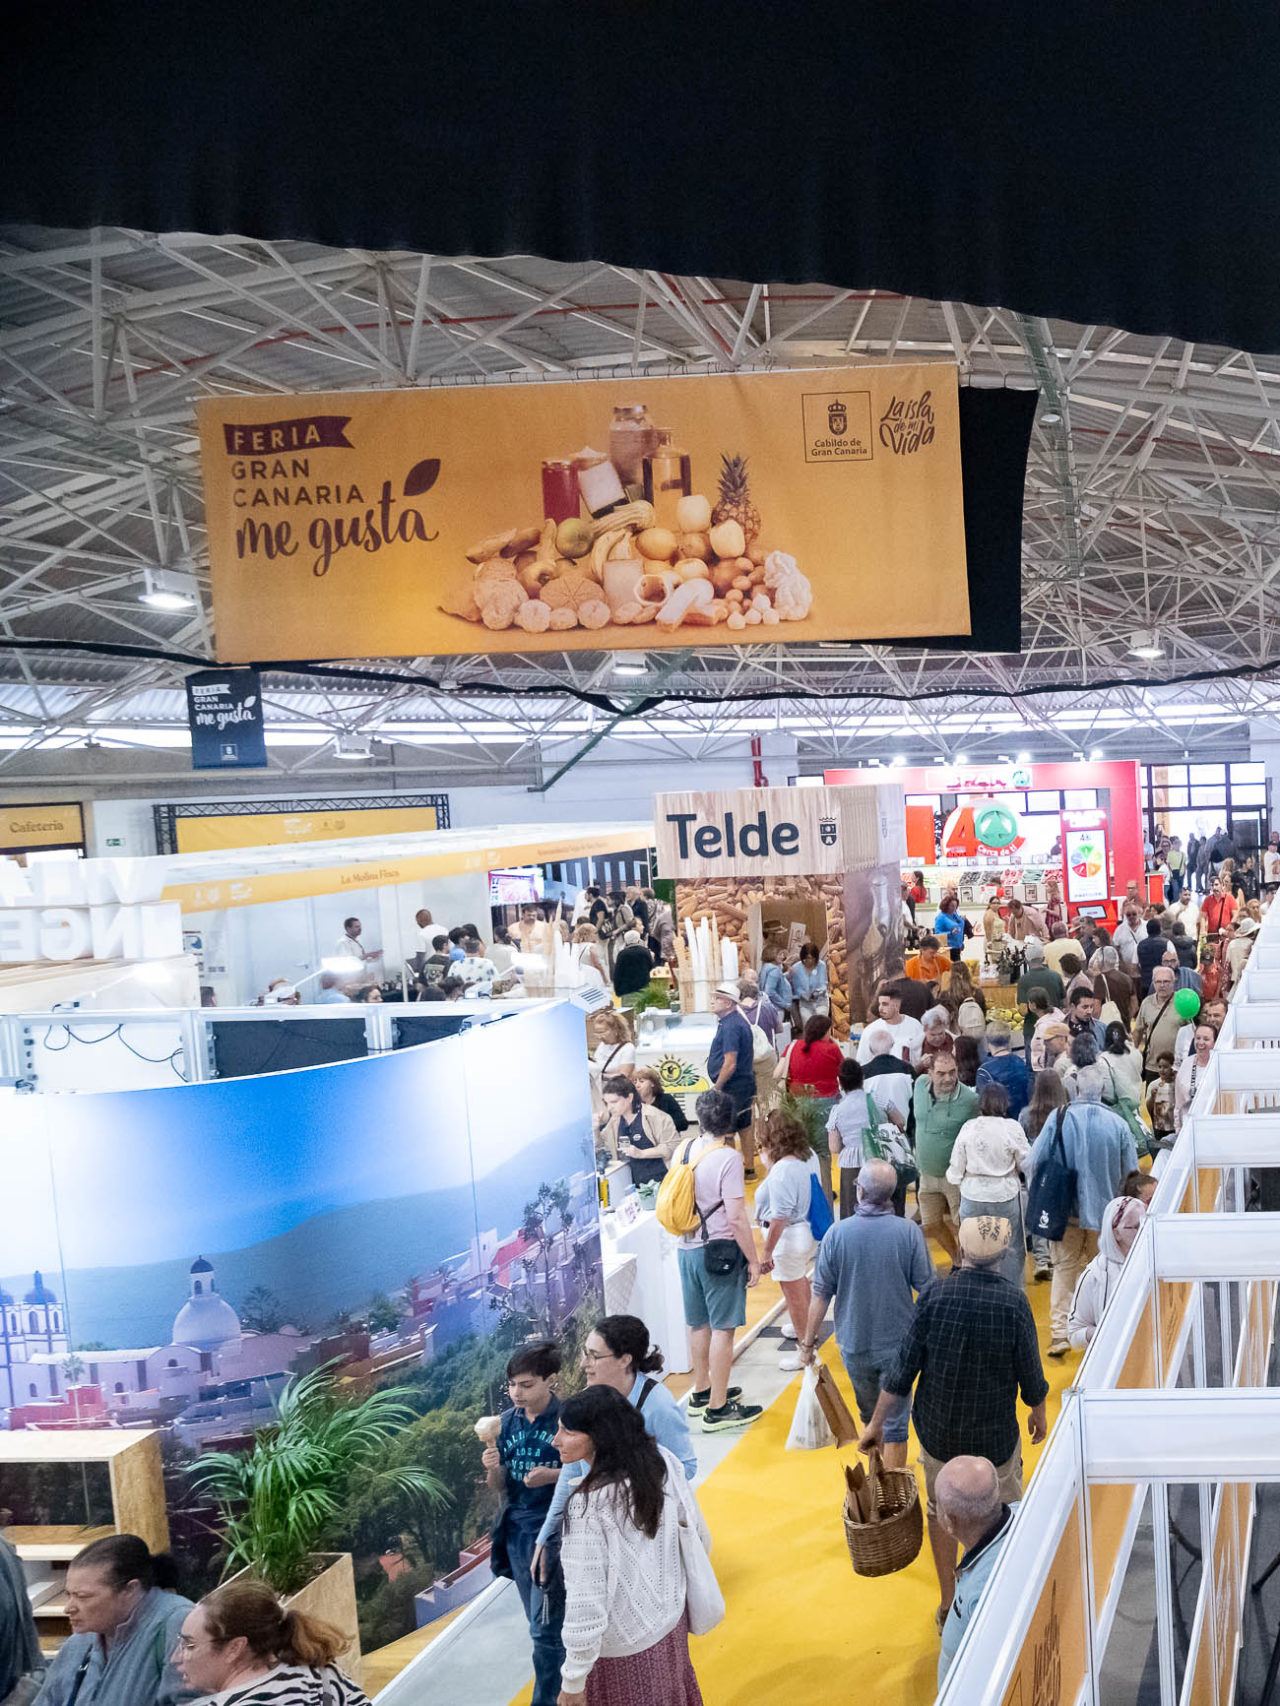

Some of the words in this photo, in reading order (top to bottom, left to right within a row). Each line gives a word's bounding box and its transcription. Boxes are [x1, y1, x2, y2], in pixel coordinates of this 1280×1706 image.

[880, 396, 904, 421] La
[905, 390, 935, 424] isla
[233, 424, 321, 450] FERIA
[814, 439, 848, 447] Cabildo
[850, 438, 861, 446] de
[879, 420, 935, 455] Vida
[811, 448, 832, 456] Gran
[834, 447, 867, 455] Canaria
[232, 459, 309, 480] GRAN
[233, 484, 365, 507] CANARIA
[236, 517, 299, 560] me
[308, 480, 440, 577] gusta
[194, 703, 234, 711] CANARIA
[196, 712, 216, 725] me
[216, 702, 256, 731] gusta
[666, 811, 799, 859] Telde
